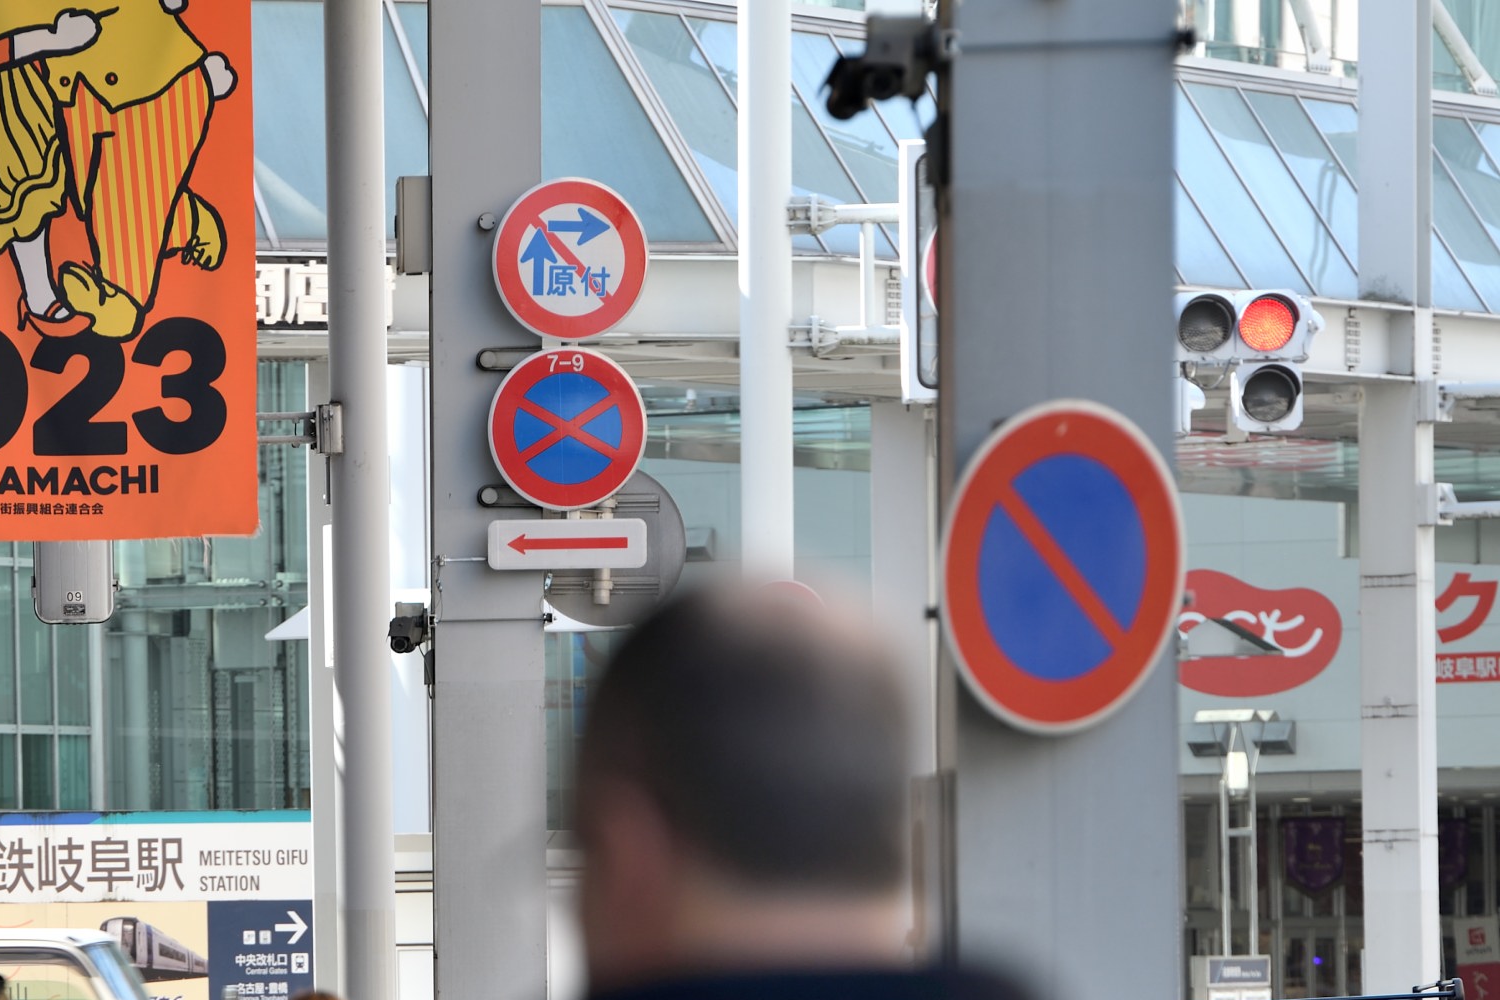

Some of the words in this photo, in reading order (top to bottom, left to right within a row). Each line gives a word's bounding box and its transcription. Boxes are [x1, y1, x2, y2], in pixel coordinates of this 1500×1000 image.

[546, 265, 611, 297] 原付
[547, 353, 584, 372] 7-9
[66, 591, 82, 602] 09
[1436, 657, 1500, 679] 岐阜駅
[199, 849, 272, 866] MEITETSU
[276, 849, 308, 866] GIFU
[199, 875, 260, 892] STATION
[235, 953, 288, 967] 中央改札口
[245, 967, 268, 975] Central
